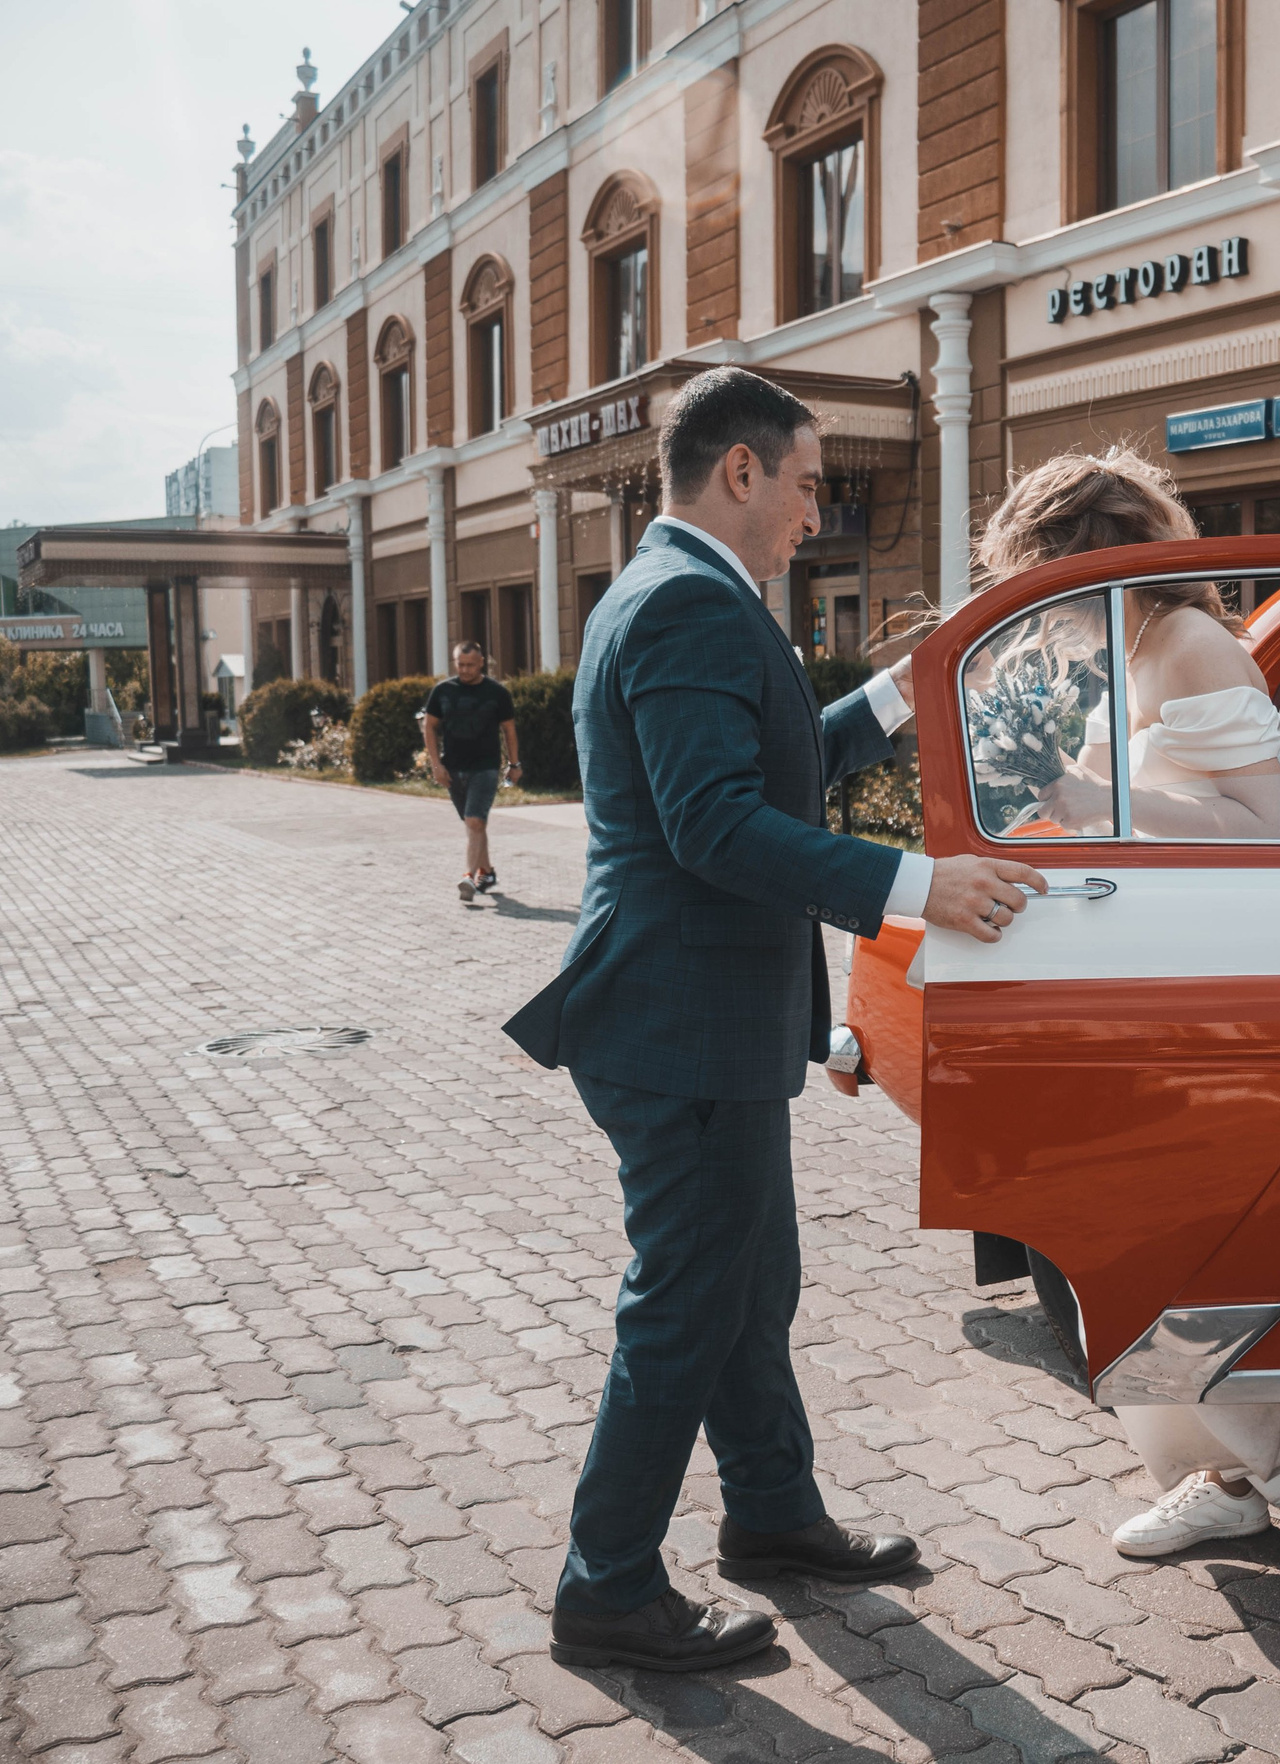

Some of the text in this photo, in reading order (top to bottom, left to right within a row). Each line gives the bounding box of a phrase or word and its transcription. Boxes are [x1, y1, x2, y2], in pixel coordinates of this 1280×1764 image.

[1047, 236, 1249, 324] РЕСТОРАН
[1170, 419, 1215, 436] МАРШАЛА
[1215, 410, 1262, 429] ЗАХАРОВА
[6, 625, 64, 640] КЛИНИКА
[72, 624, 86, 637] 24
[89, 622, 125, 637] ЧАСА
